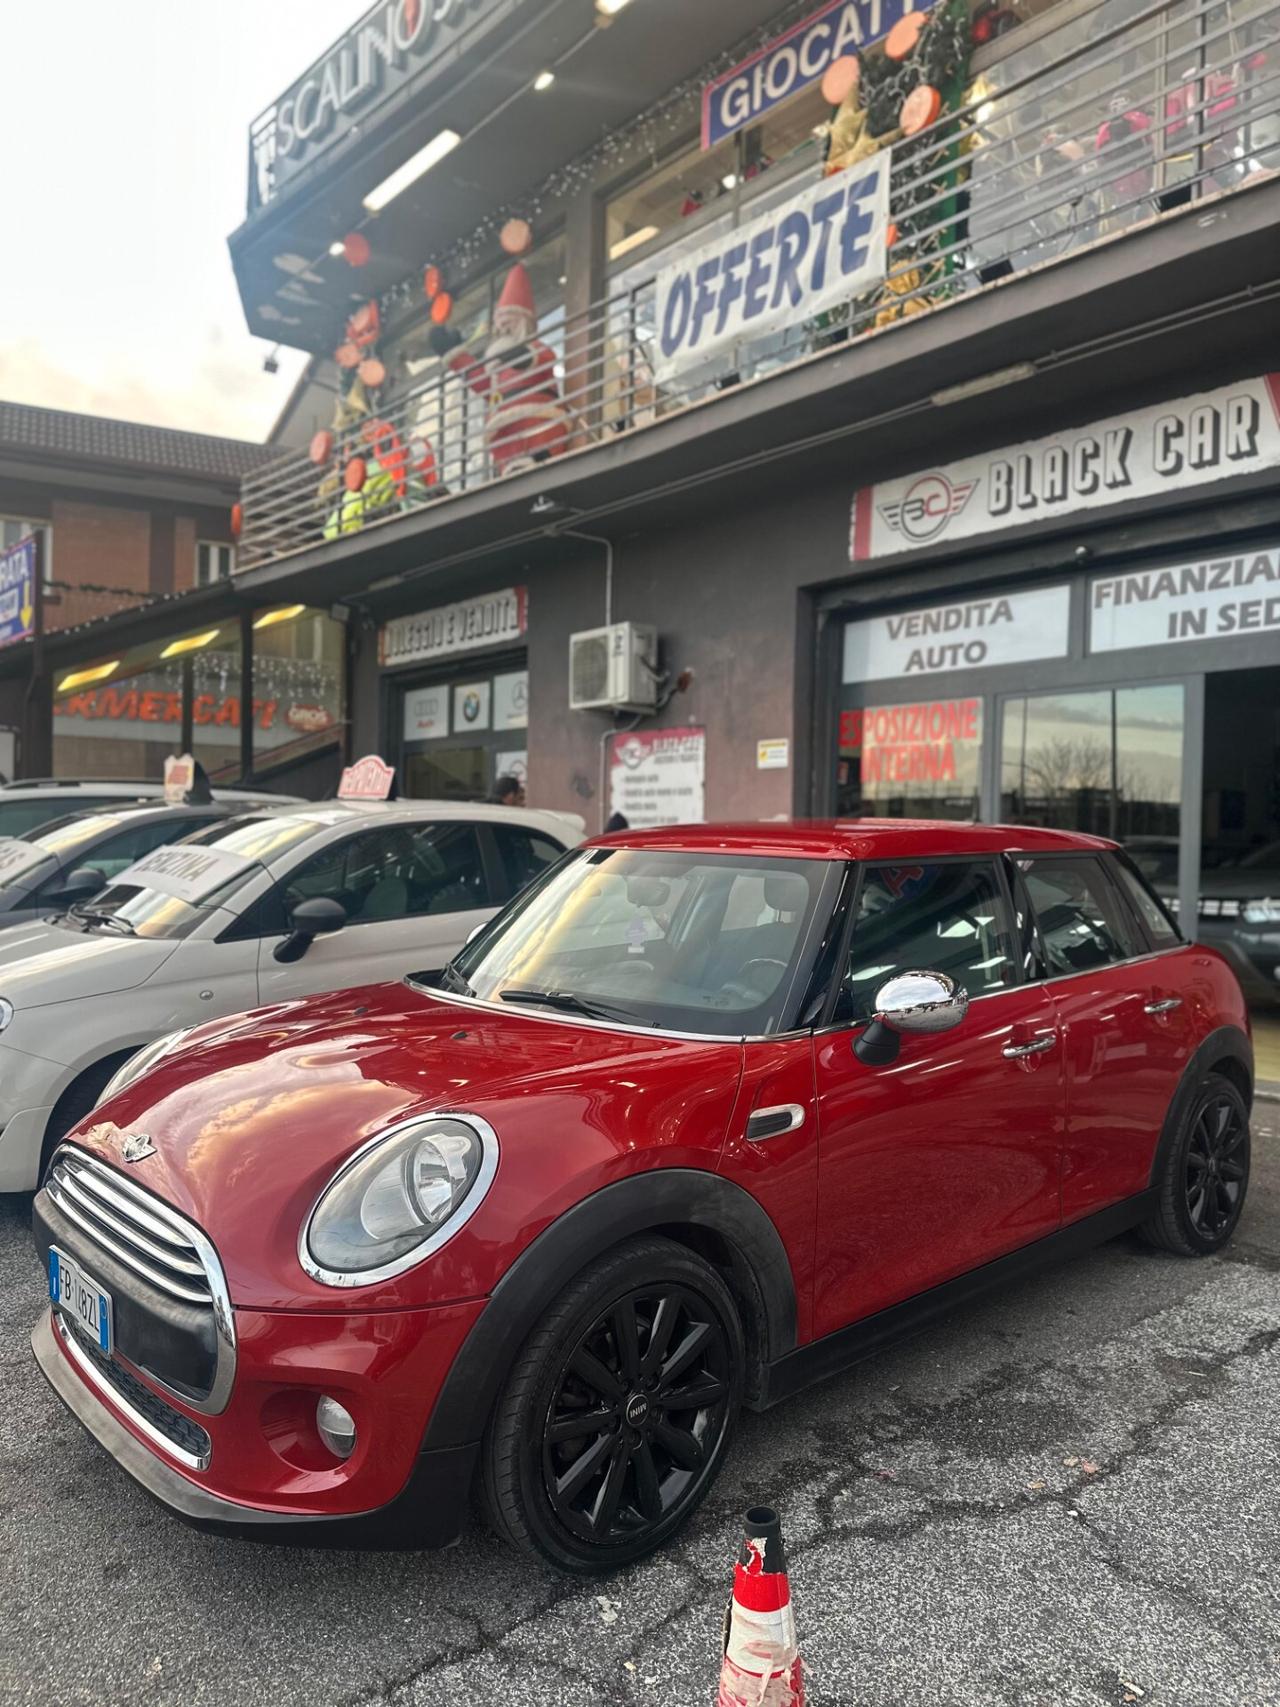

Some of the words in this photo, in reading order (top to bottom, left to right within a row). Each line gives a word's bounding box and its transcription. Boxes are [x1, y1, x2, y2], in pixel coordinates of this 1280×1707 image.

[720, 0, 913, 128] GIOCAT
[661, 170, 879, 358] OFFERTE
[988, 427, 1133, 516] BLACK
[1153, 394, 1260, 476] CAR
[1094, 553, 1280, 609] FINANZIA
[886, 599, 1014, 641] VENDITA
[1167, 607, 1208, 639] IN
[904, 640, 988, 673] AUTO
[838, 699, 979, 748] ESPOSIZIONE
[860, 743, 956, 784] INTERNA
